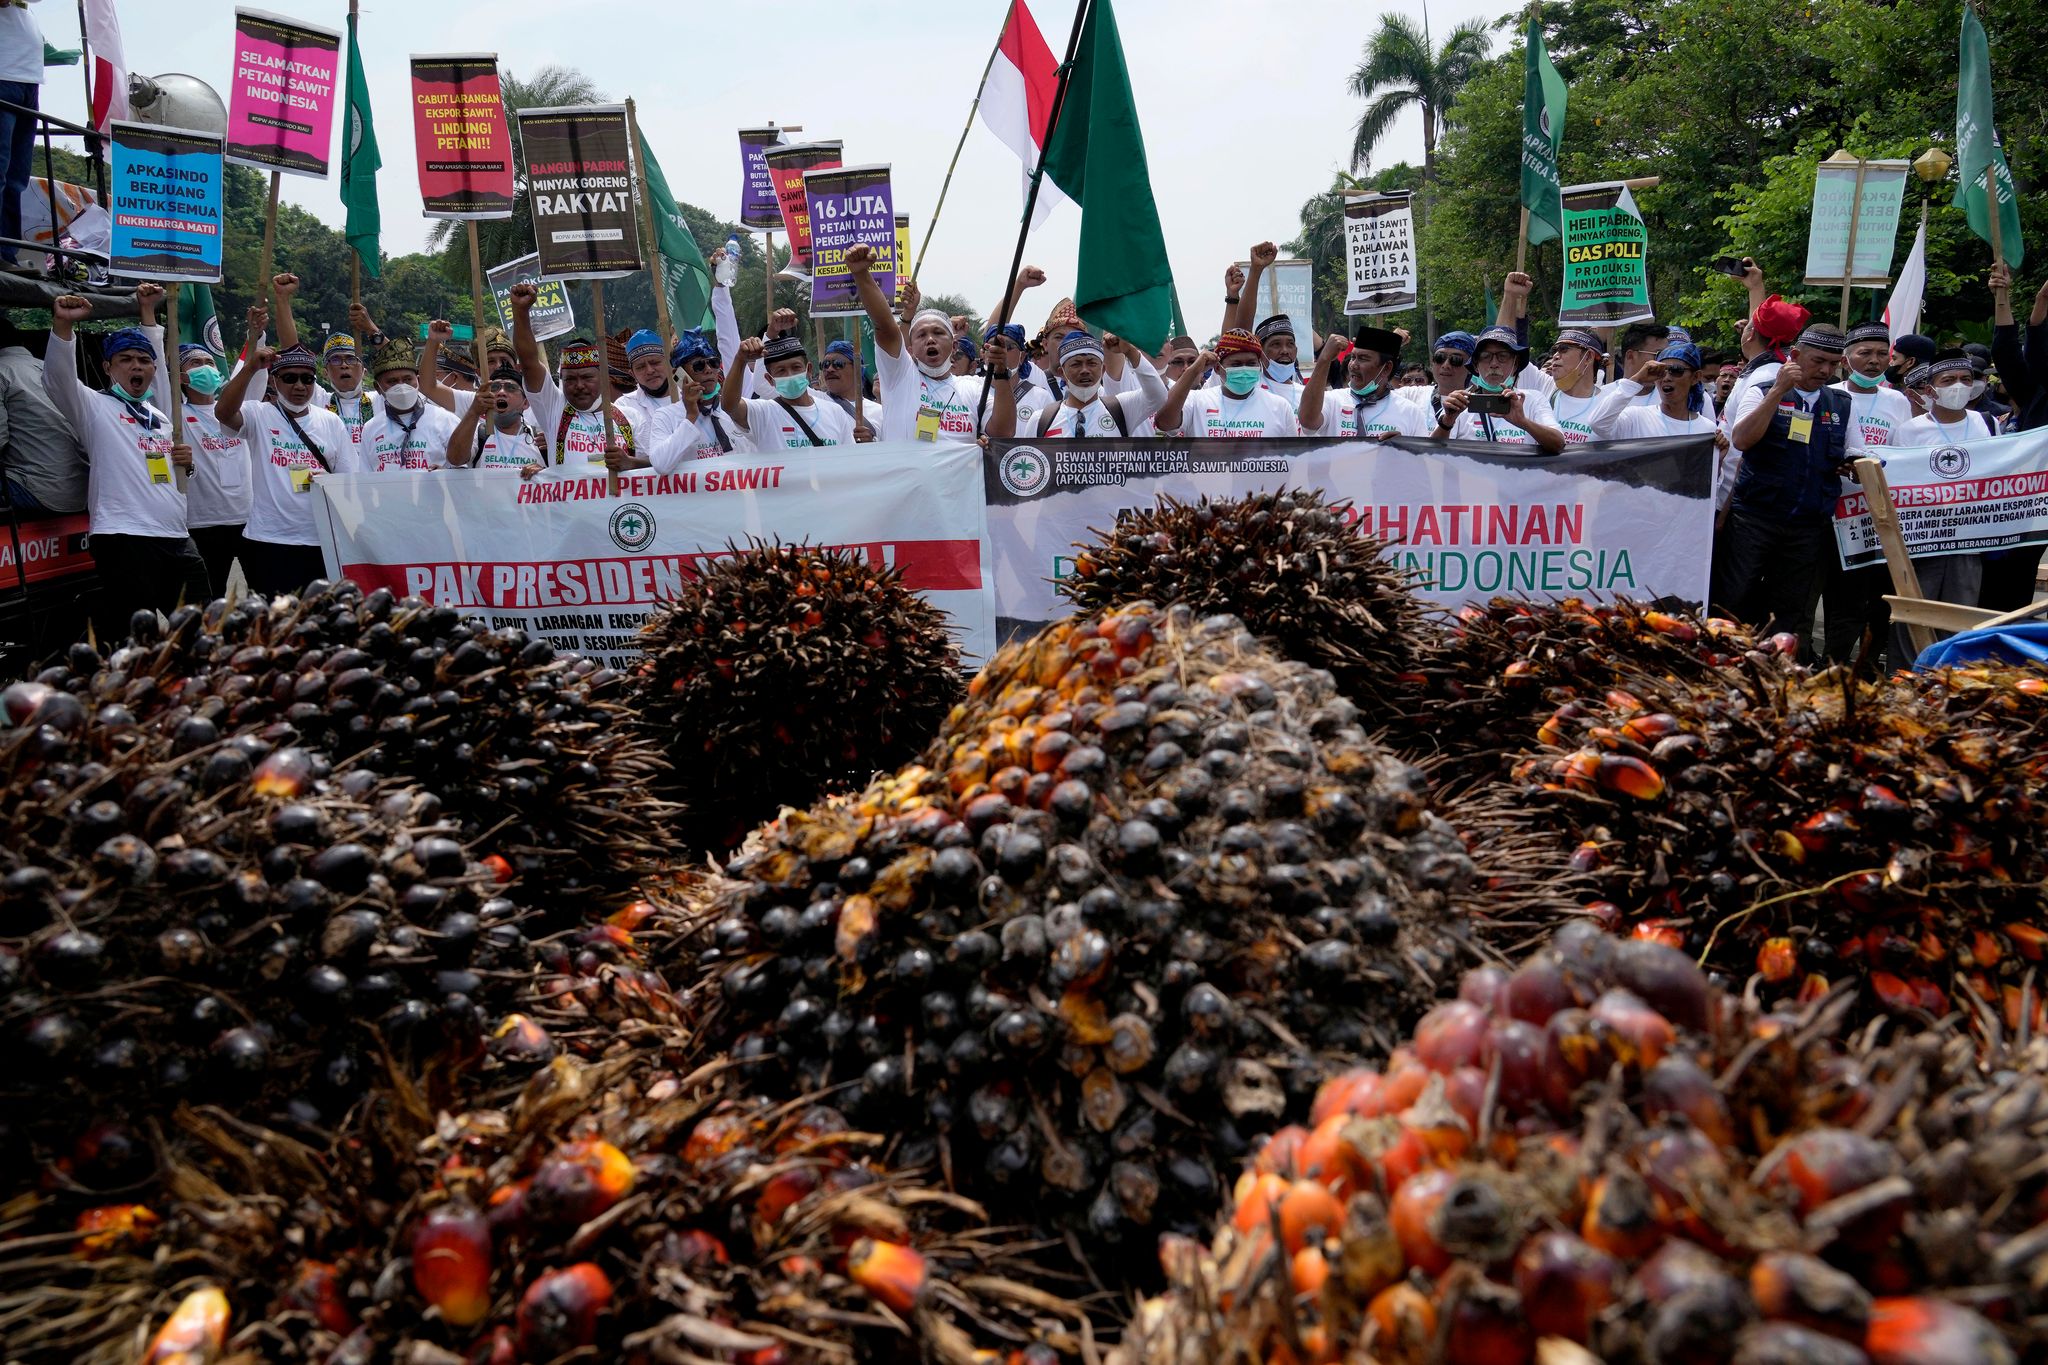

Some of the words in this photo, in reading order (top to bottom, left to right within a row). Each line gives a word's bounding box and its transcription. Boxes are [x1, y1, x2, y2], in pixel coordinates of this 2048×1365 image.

[241, 51, 330, 81] SELAMATKAN
[238, 67, 286, 87] PETANI
[288, 78, 330, 97] SAWIT
[246, 86, 318, 112] INDONESIA
[418, 94, 448, 104] CABUT
[450, 94, 500, 104] LARANGAN
[426, 108, 461, 118] EKSPOR
[463, 108, 497, 118] SAWIT,
[268, 119, 296, 130] APKASINDO
[434, 122, 492, 135] LINDUNGI
[437, 137, 490, 150] PETANI!!
[126, 164, 208, 184] APKASINDO
[530, 162, 580, 175] BANGUN
[583, 160, 626, 172] PABRIK
[130, 180, 206, 200] BERJUANG
[532, 178, 580, 191] MINYAK
[580, 176, 628, 189] GORENG
[117, 196, 168, 212] UNTUK
[167, 201, 218, 218] SEMUA
[536, 192, 629, 216] RAKYAT
[815, 200, 837, 220] 16
[840, 196, 888, 217] JUTA
[150, 218, 186, 230] HARGA
[820, 220, 856, 234] PETANI
[860, 218, 884, 230] DAN
[1348, 222, 1378, 234] PETANI
[1380, 218, 1408, 229] SAWIT
[1569, 217, 1596, 231] HEII
[815, 234, 856, 248] PEKERJA
[857, 232, 892, 243] SAWIT
[1352, 228, 1407, 243] ADALAH
[1569, 230, 1606, 242] MINYAK
[1607, 228, 1642, 238] GORENG,
[150, 242, 182, 250] APKASINDO
[1353, 240, 1408, 255] PAHLAWAN
[1569, 245, 1603, 262] GAS
[1605, 242, 1640, 258] POLL
[1354, 252, 1410, 268] DEVISA
[1355, 265, 1410, 281] NEGARA
[1575, 263, 1635, 277] PRODUKSI
[1568, 277, 1608, 290] MINYAK
[1609, 275, 1641, 286] CURAH
[536, 306, 566, 317] SAWIT
[1207, 420, 1264, 429] SELAMATKAN
[1865, 426, 1888, 437] SAWIT
[1208, 429, 1236, 437] PETANI
[1564, 432, 1588, 443] SAWIT
[404, 450, 424, 459] SAWIT
[1055, 452, 1096, 463] DEWAN
[1098, 451, 1151, 462] PIMPINAN
[1154, 451, 1189, 461] PUSAT
[1055, 463, 1106, 474] ASOSIASI
[1108, 462, 1146, 473] PETANI
[1149, 462, 1191, 473] KELAPA
[1192, 462, 1226, 473] SAWIT
[1229, 461, 1289, 473] INDONESIA
[518, 478, 607, 504] HARAPAN
[617, 472, 696, 498] PETANI
[704, 466, 784, 492] SAWIT
[1055, 474, 1127, 486] (APKASINDO)
[1845, 496, 1868, 514] PA
[1890, 485, 1978, 506] PRESIDEN
[1981, 474, 2046, 498] JOKOWI
[1899, 511, 1922, 521] EGERA
[1924, 508, 1953, 518] CABUT
[1955, 505, 2001, 516] LARANGAN
[2002, 501, 2033, 511] EKSPOR
[1851, 532, 1859, 540] 2.
[1914, 520, 1940, 530] JAMBI
[1942, 515, 1991, 527] SESUAIKAN
[1993, 511, 2024, 522] DENGAN
[2025, 508, 2048, 518] HARG
[1864, 539, 1880, 549] DISE
[1930, 529, 1956, 539] JAMBI
[1957, 538, 2000, 549] MERANGIN
[2000, 535, 2021, 544] JAMBI
[1393, 550, 1636, 592] INDONESIA
[406, 564, 485, 607] PAK
[493, 558, 684, 608] PRESIDEN
[534, 614, 604, 630] LARANGAN
[609, 612, 648, 629] EKSPO
